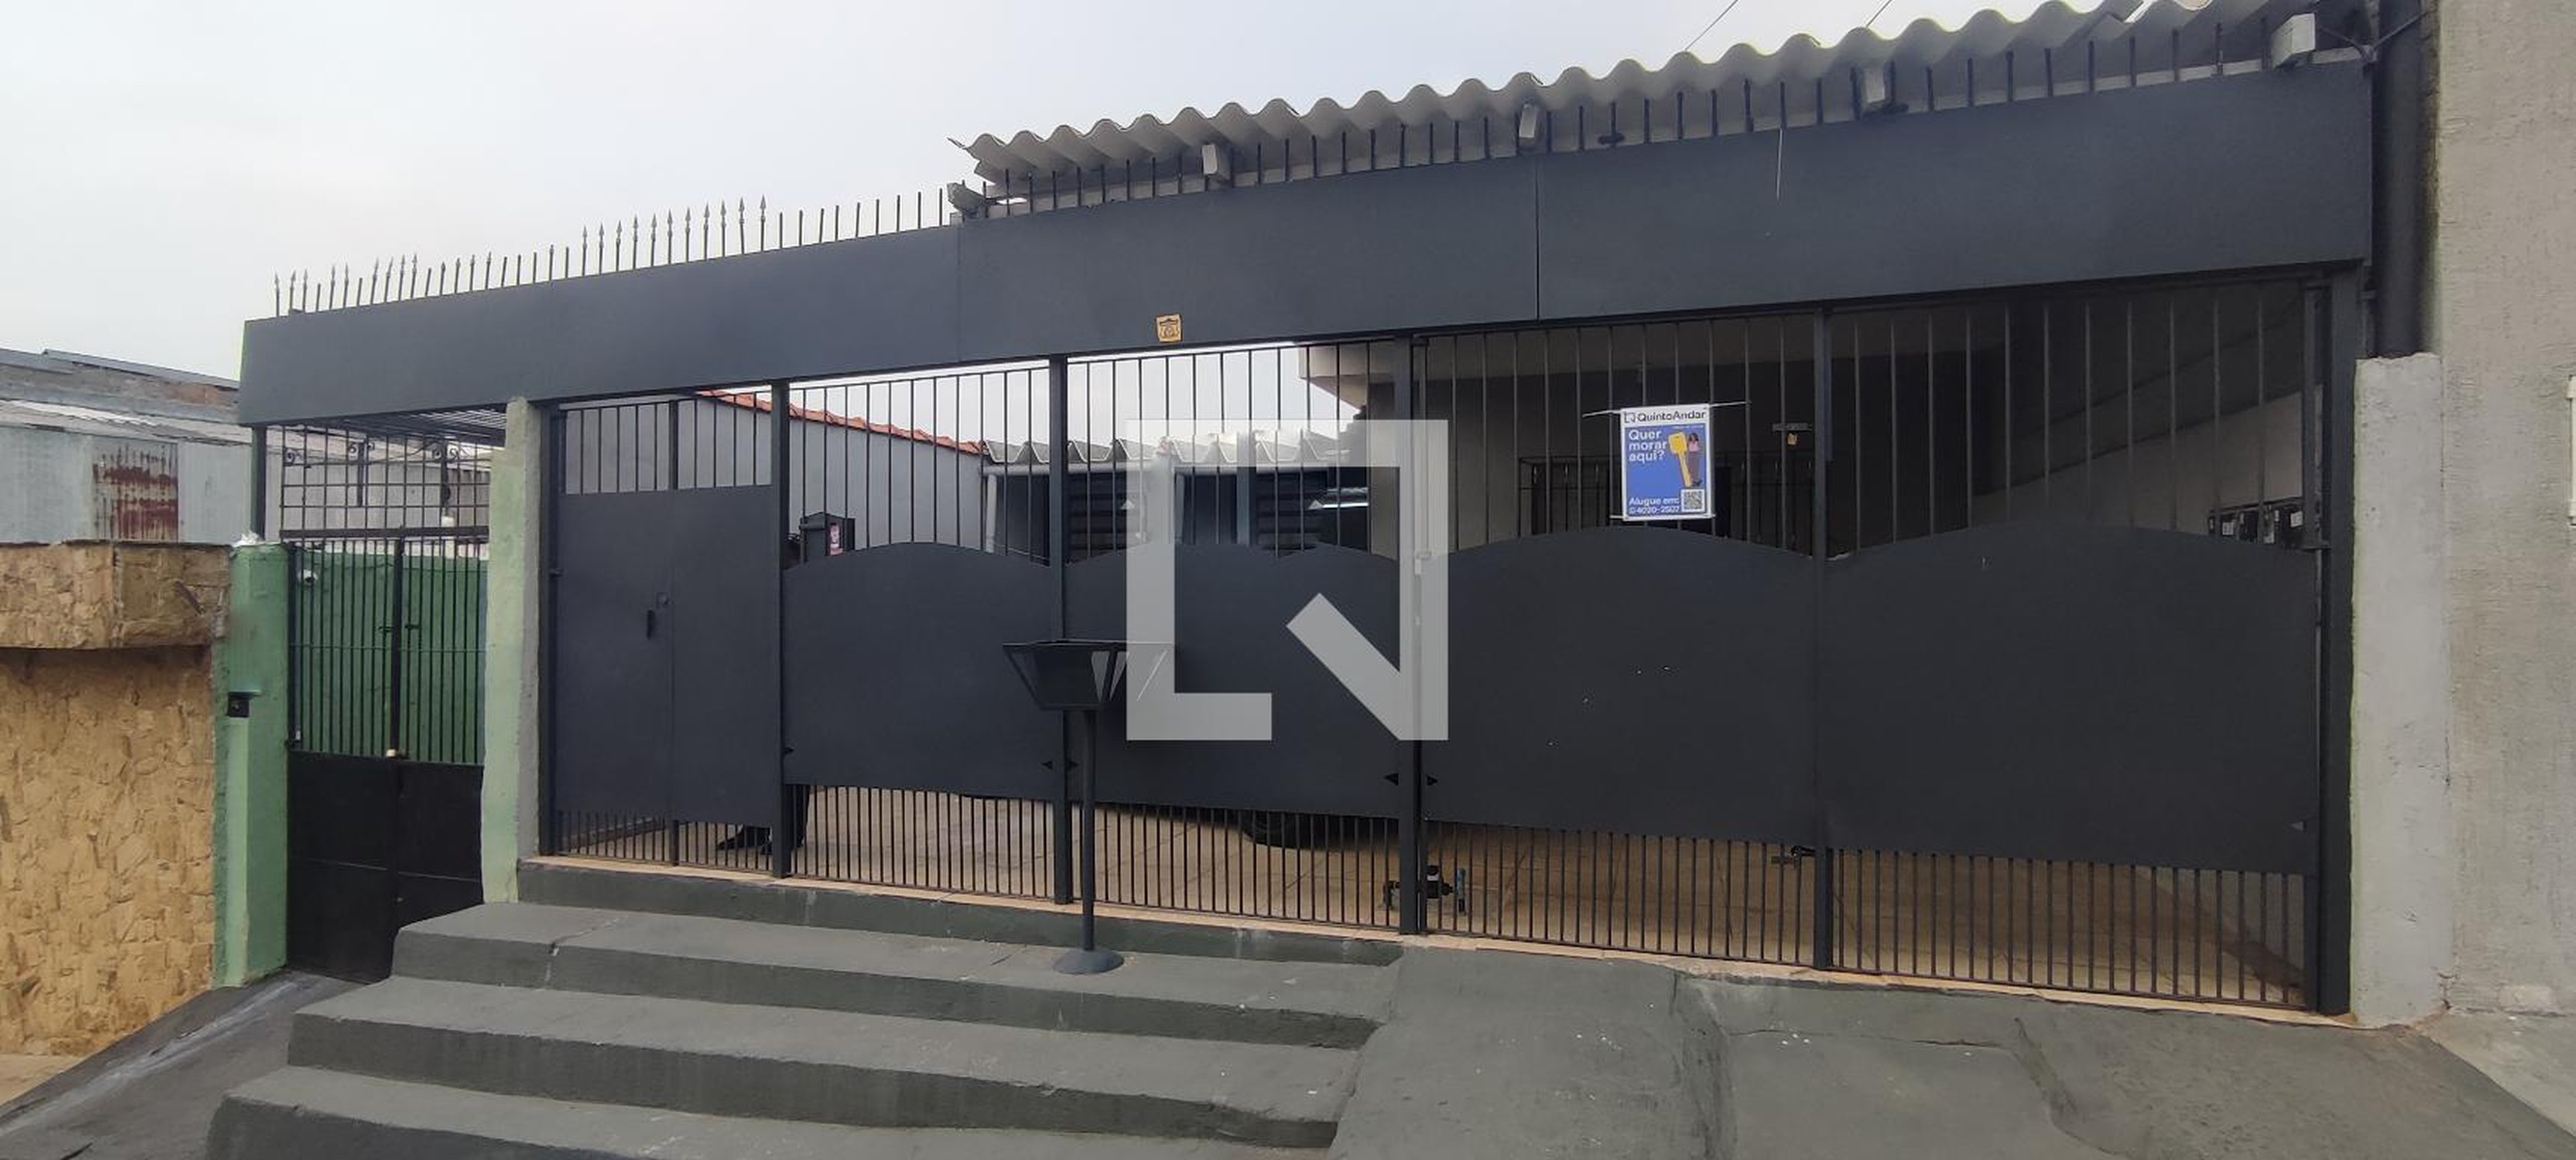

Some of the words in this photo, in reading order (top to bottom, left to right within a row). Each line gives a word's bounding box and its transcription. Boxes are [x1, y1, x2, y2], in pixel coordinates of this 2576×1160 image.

[1638, 410, 1706, 422] QuintoAndar
[1629, 429, 1662, 440] Quer
[1629, 441, 1667, 451] morar
[1629, 450, 1664, 464] aqui?
[1629, 497, 1661, 507] Alugue
